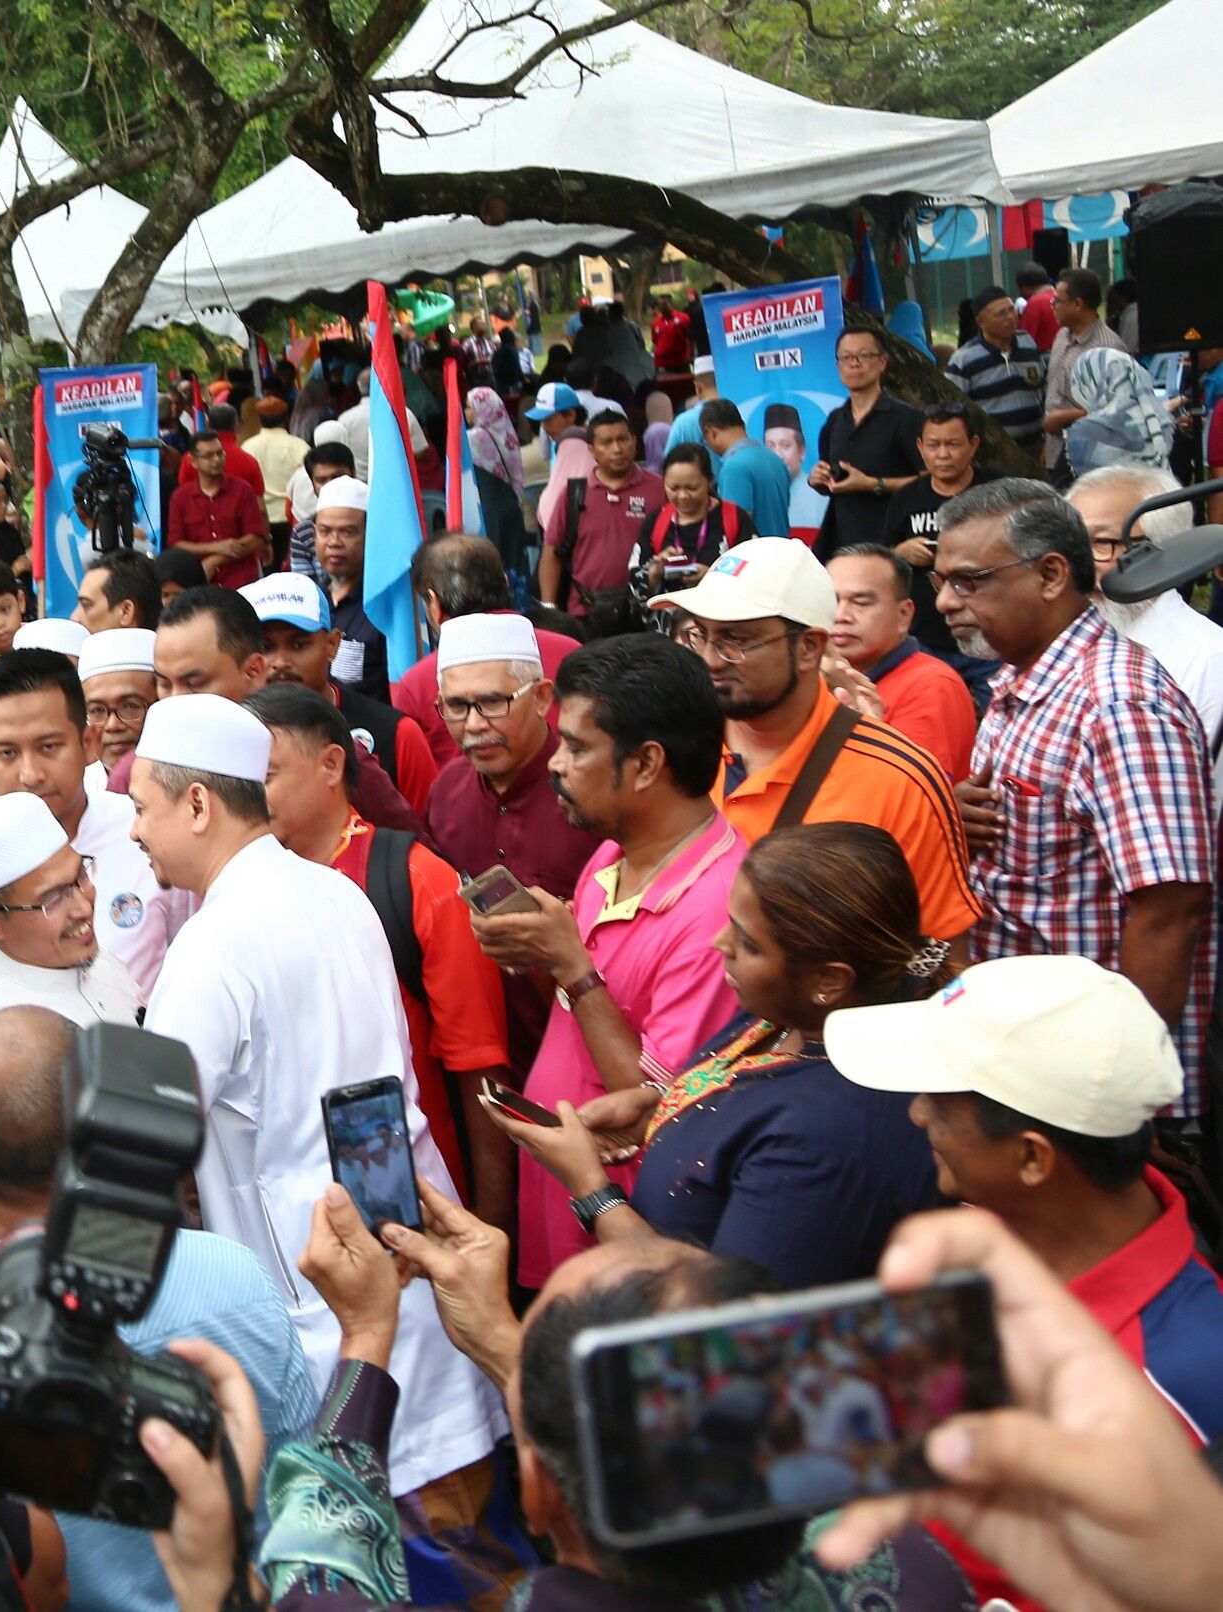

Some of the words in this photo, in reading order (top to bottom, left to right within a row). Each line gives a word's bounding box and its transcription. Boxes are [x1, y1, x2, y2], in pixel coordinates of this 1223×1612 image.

[731, 295, 817, 331] KEADILAN
[773, 315, 818, 332] MALAYSIA
[61, 377, 137, 403] KEADILAN
[910, 511, 942, 534] WH
